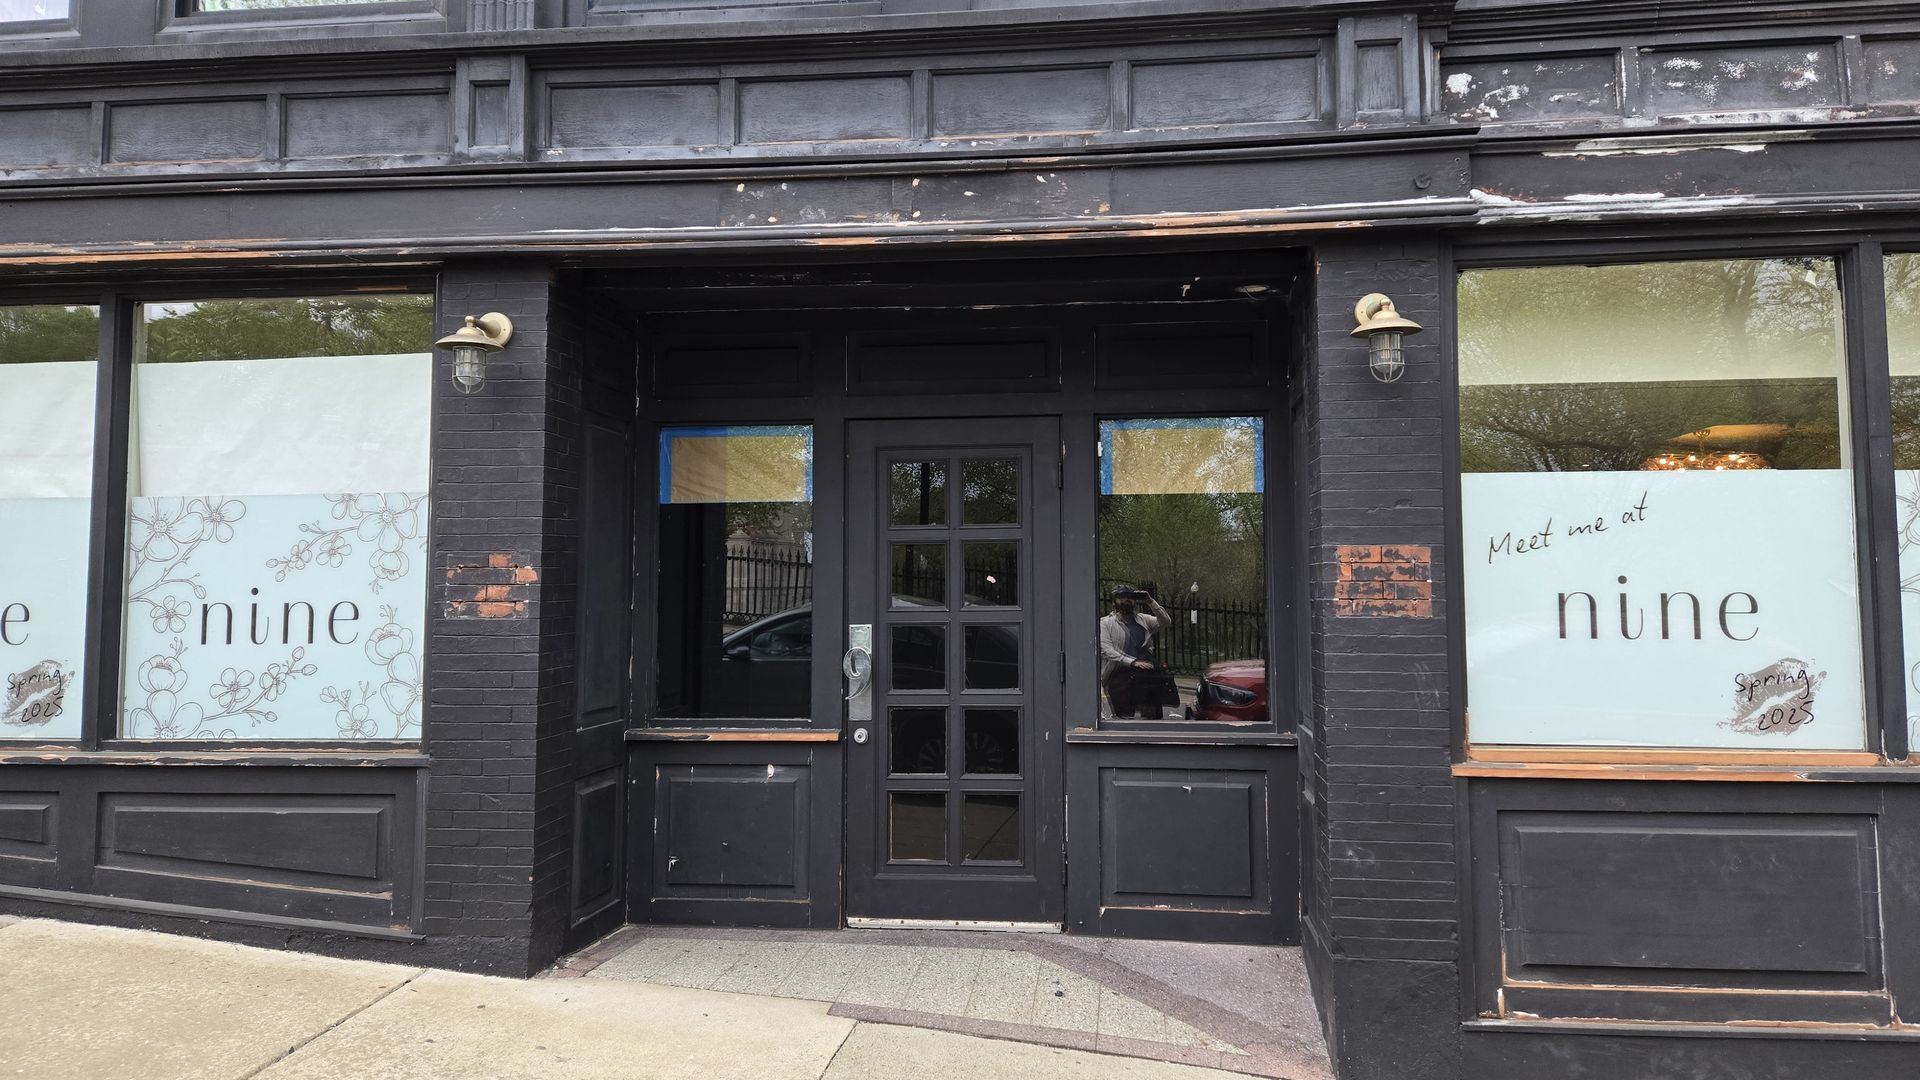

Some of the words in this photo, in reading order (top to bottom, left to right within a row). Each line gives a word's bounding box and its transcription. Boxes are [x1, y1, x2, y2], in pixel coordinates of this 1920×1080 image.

[1488, 516, 1553, 565] Meet
[1568, 516, 1609, 537] me
[1621, 489, 1649, 525] at
[200, 587, 360, 646] nine
[1557, 575, 1760, 642] nine
[7, 669, 63, 699] Spring
[1734, 669, 1810, 702] Spring
[20, 695, 64, 723] 2025
[1757, 700, 1815, 731] 2025
